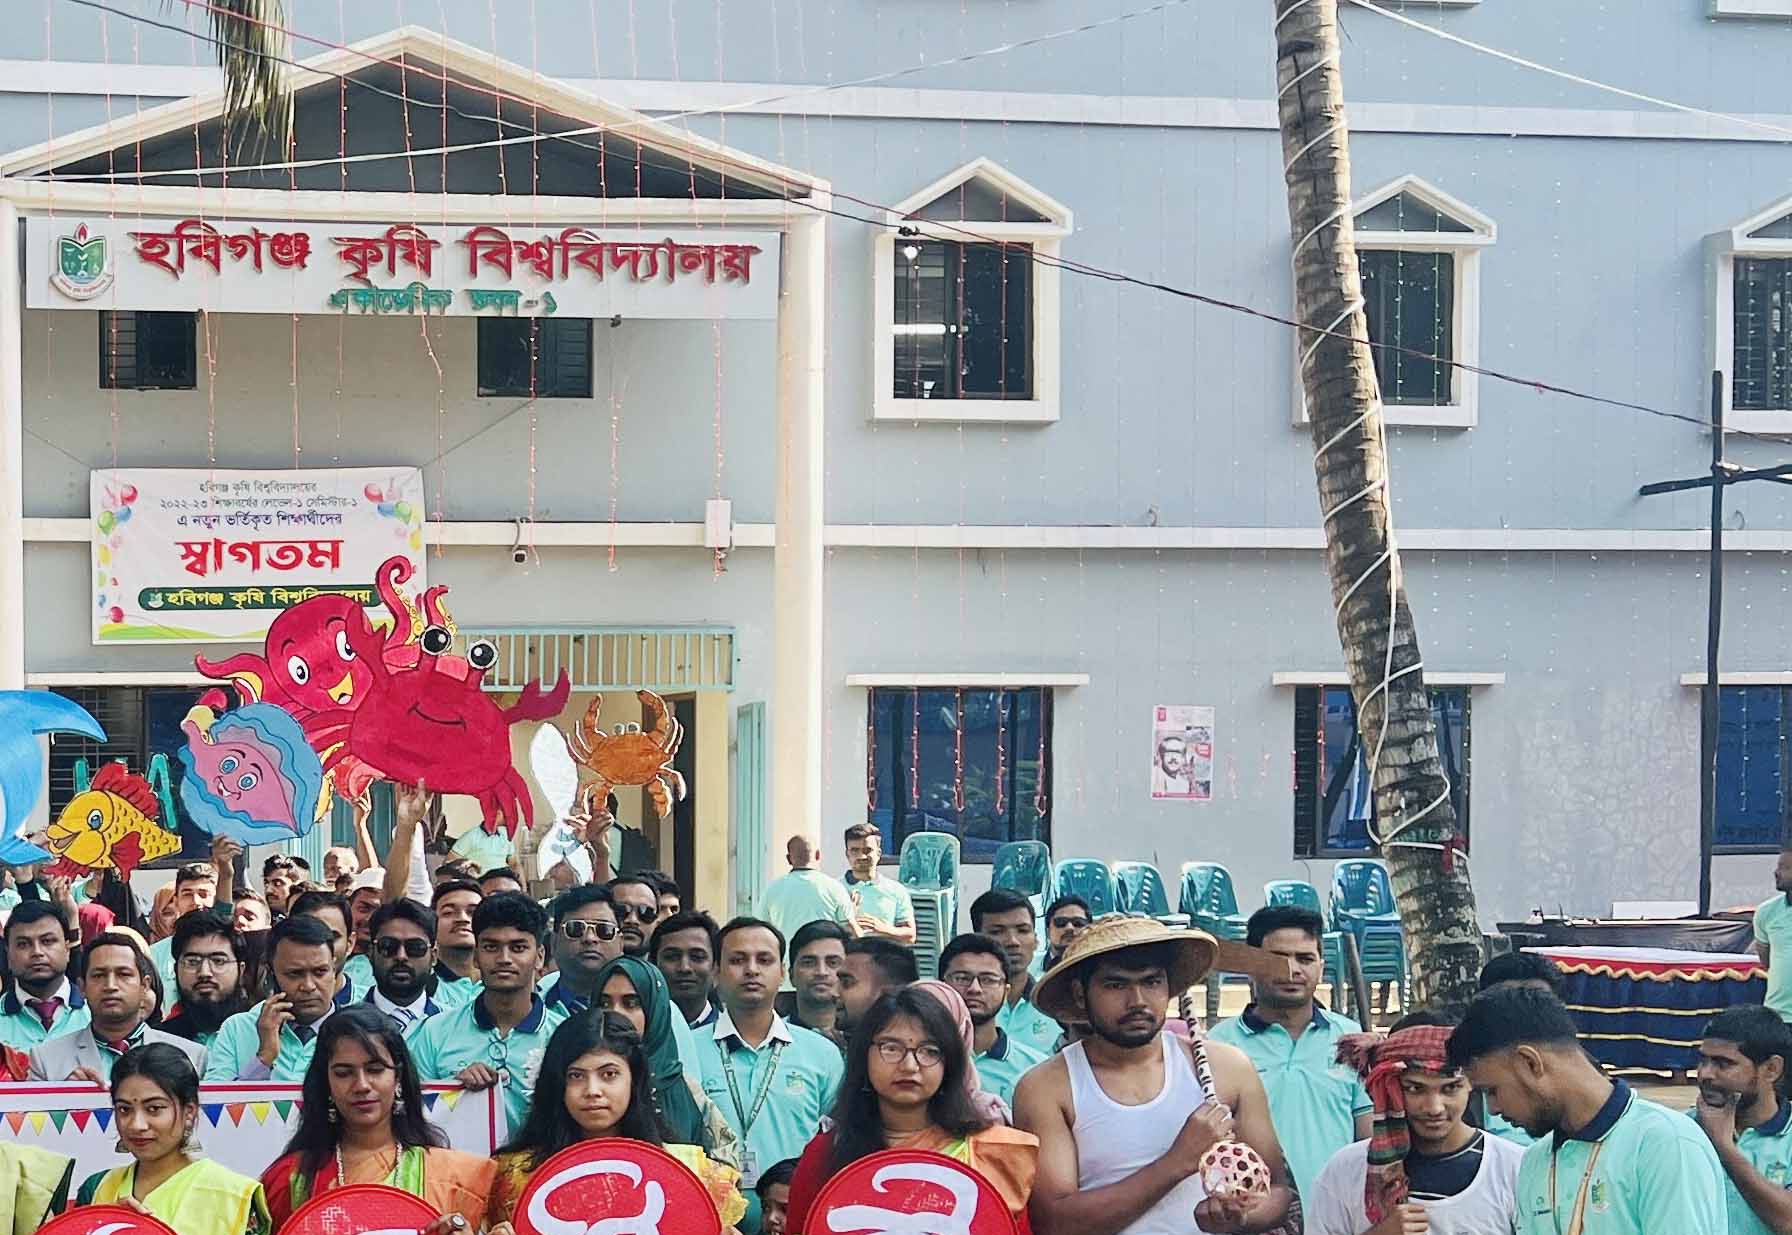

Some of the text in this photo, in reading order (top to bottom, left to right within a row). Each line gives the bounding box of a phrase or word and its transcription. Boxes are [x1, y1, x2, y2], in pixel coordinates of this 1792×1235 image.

[128, 220, 762, 289] হবিগঞ্জ কৃষি বিশ্ববিদ্যালয়
[177, 510, 343, 532] এ নতুন ভর্তিকৃত শিক্ষার্থীদের
[175, 538, 345, 577] স্বাগতম
[167, 588, 224, 607] হবিগঞ্জ
[231, 588, 265, 609] কৃষি
